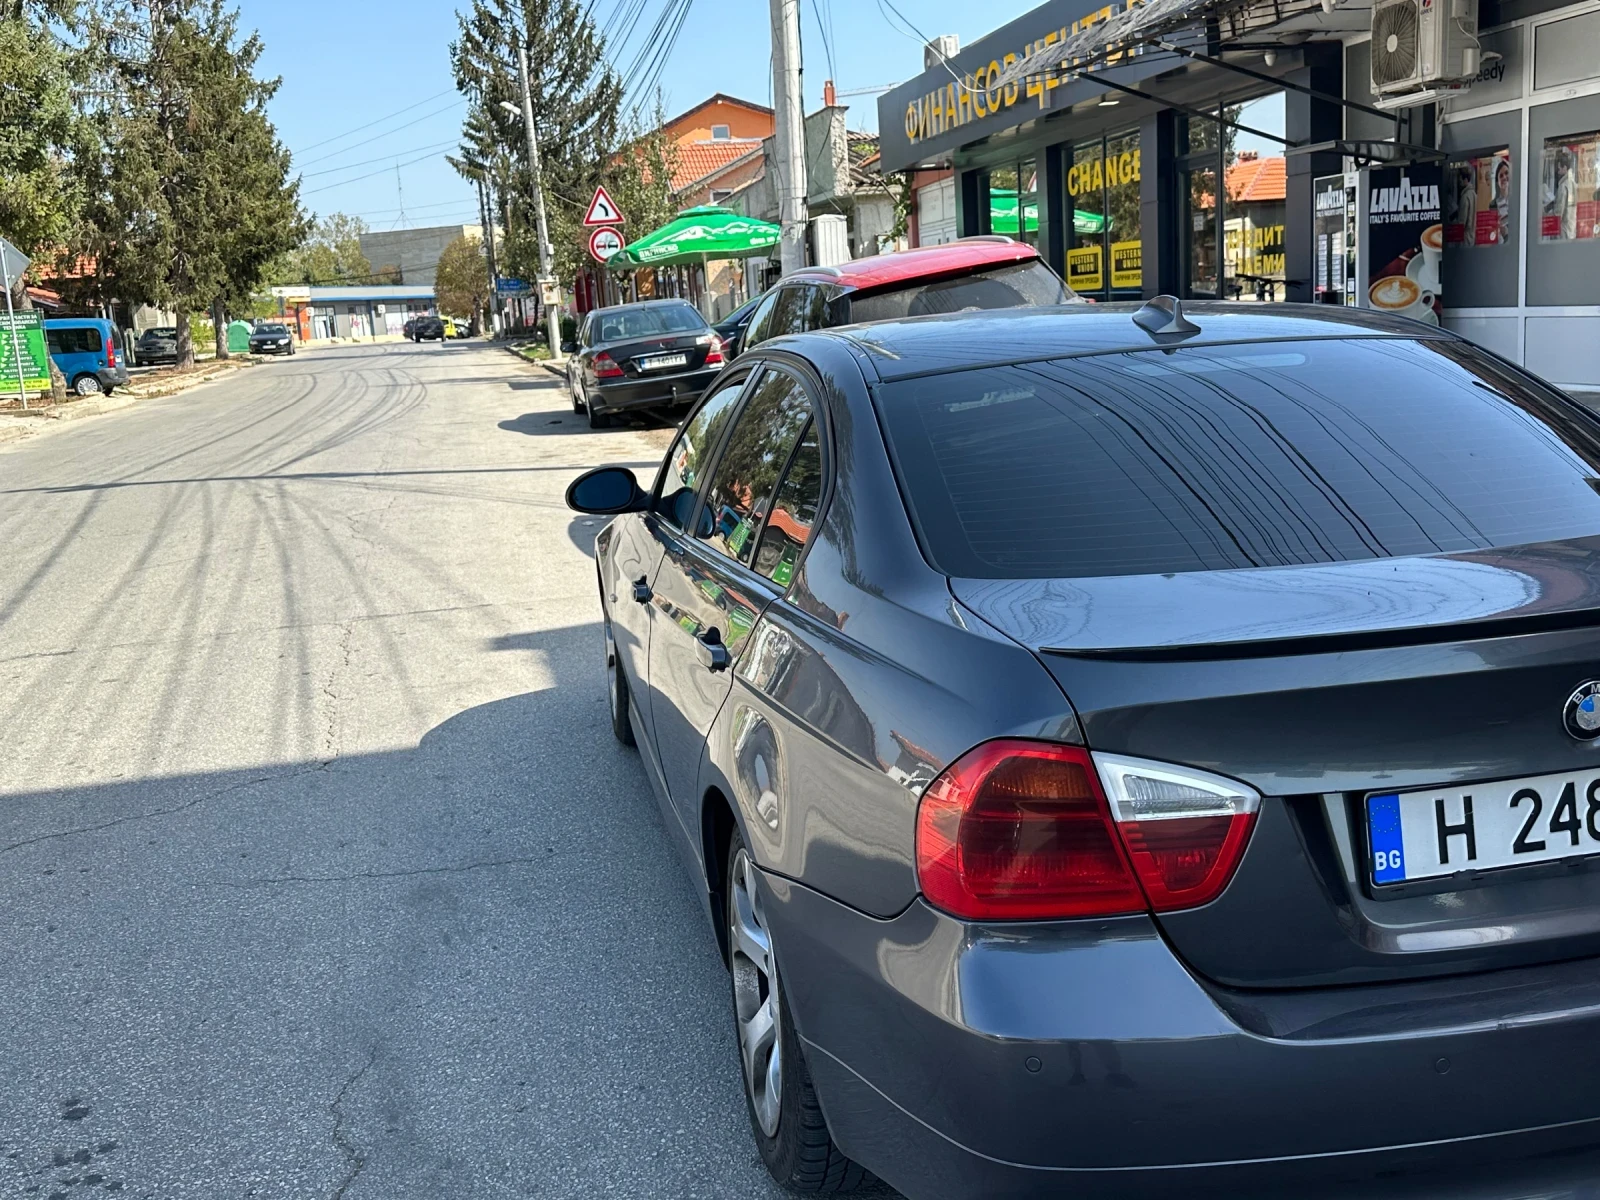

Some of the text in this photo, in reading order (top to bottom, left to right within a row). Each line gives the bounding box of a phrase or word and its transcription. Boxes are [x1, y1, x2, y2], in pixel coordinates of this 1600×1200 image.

[905, 52, 1018, 145] ФИНАНСОВ
[1068, 149, 1140, 197] CHANGE
[1316, 185, 1344, 210] LAVAZZA
[1370, 177, 1440, 213] LAVAZZA
[1370, 211, 1440, 224] ITALY'S FAVOURITE COFFEE
[1071, 254, 1094, 265] WESTERN
[1115, 248, 1141, 260] WESTERN
[1123, 258, 1141, 269] UNION
[1077, 263, 1094, 273] UNION
[1434, 796, 1476, 864] H
[1375, 850, 1401, 871] BG
